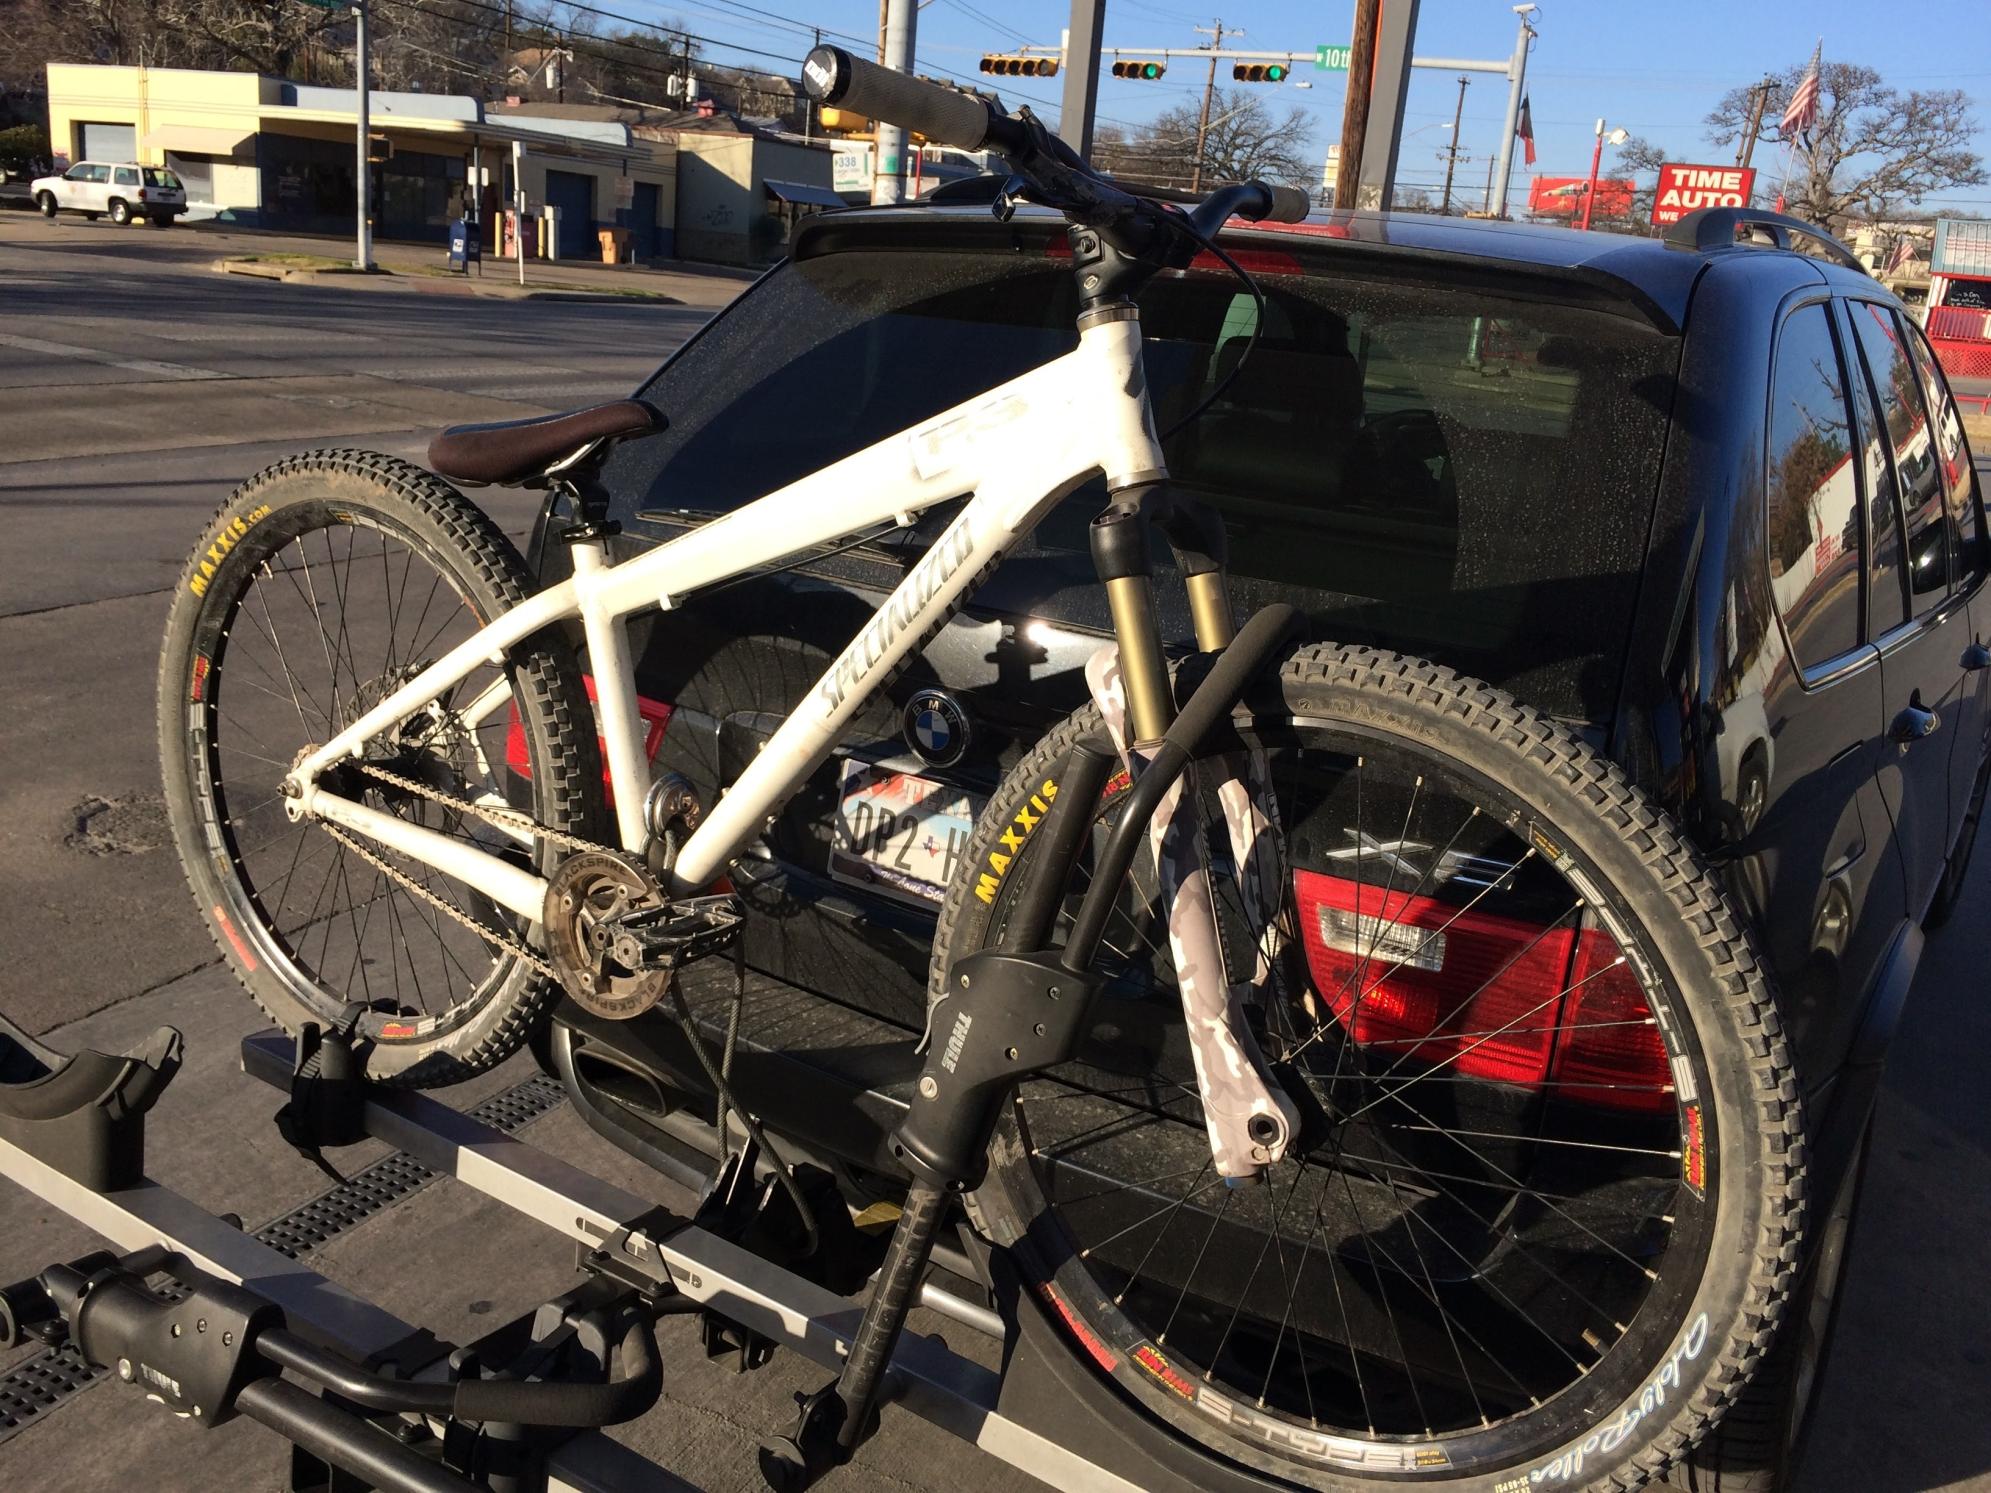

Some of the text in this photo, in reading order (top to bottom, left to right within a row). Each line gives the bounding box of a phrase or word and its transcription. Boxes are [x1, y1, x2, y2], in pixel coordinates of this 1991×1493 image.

[1660, 189, 1743, 209] AUTO
[1671, 168, 1743, 190] TIME
[1658, 211, 1679, 221] WE
[822, 517, 974, 718] SPECIALIZED
[852, 800, 919, 871] DP2
[974, 779, 1059, 905] MAXXIS
[941, 1011, 972, 1074] THULE
[1198, 1386, 1403, 1466] S-TYPE
